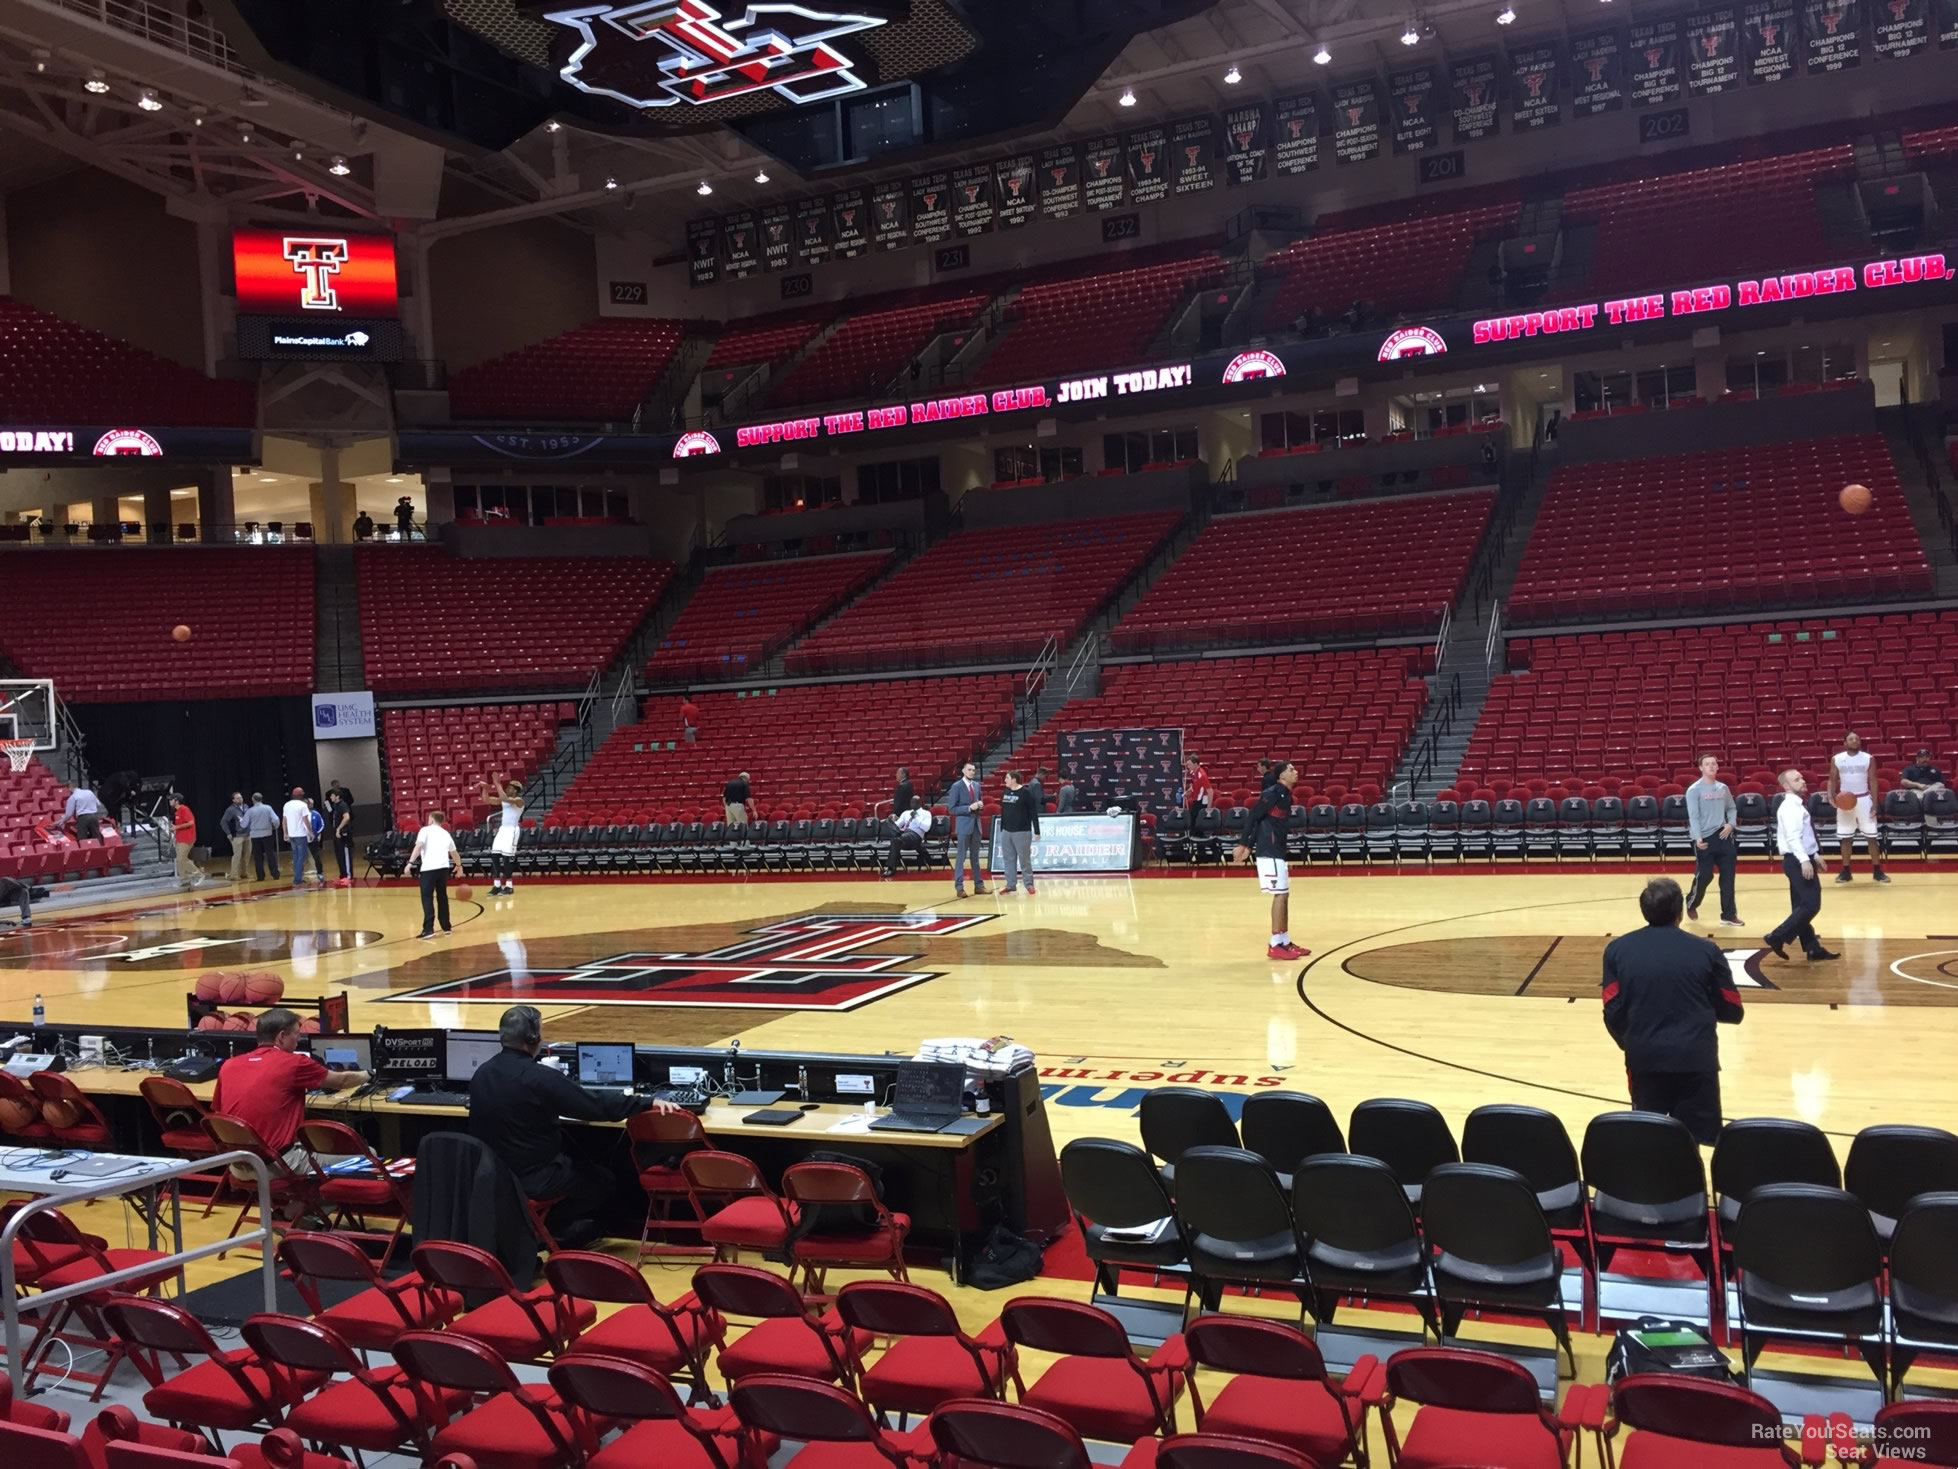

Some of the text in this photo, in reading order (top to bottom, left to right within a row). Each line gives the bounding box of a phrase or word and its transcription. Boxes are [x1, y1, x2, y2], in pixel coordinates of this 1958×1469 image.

[1876, 18, 1924, 35] CHAMPIONS
[1809, 32, 1856, 48] CHAMPIONS
[1887, 30, 1914, 42] BIG 12
[1820, 43, 1846, 55] BIG 12
[1874, 36, 1928, 53] TOURNAMENT
[1760, 47, 1783, 57] NCAA
[1807, 49, 1860, 66] CONFERENCE
[1893, 48, 1911, 59] 1999
[1690, 56, 1734, 71] CHAMPIONS
[1754, 53, 1789, 67] MIDWEST
[1825, 61, 1843, 71] 1999
[1633, 66, 1676, 81] CHAMPIONS
[1701, 67, 1725, 78] BIG 12
[1753, 62, 1792, 76] REGIONAL
[1585, 81, 1608, 93] NCAA
[1643, 77, 1667, 88] BIG 12
[1689, 72, 1738, 88] TOURNAMENT
[1591, 88, 1621, 102] REGIONAL
[1631, 83, 1680, 99] CONFERENCE
[1453, 102, 1497, 117] CO-CHAMPIONS
[1524, 97, 1547, 108] NCAA
[1227, 107, 1261, 124] MARSHA
[1514, 104, 1558, 121] SWEET SIXTEEN
[1232, 120, 1257, 135] SHARP
[1402, 116, 1425, 127] NCAA
[1458, 118, 1493, 131] CONFERENCE
[1646, 114, 1683, 137] 202
[1335, 123, 1378, 138] CHAMPIONS
[1397, 126, 1432, 141] ELITE EIGHT
[1276, 136, 1317, 151] CHAMPIONS
[1336, 142, 1378, 157] TOURNAMENT
[1407, 141, 1425, 152] 1995
[1277, 145, 1318, 160] SOUTHWEST
[1349, 152, 1366, 162] 1995
[1277, 154, 1318, 169] CONFERENCE
[1428, 157, 1456, 178] 201
[1239, 166, 1253, 176] YEAR
[1290, 164, 1307, 174] 1995
[1085, 175, 1122, 189] CHAMPIONS
[1179, 172, 1209, 184] SWEET
[1130, 182, 1169, 197] CONFERENCE
[1175, 179, 1214, 193] SIXTEEN
[1006, 197, 1026, 207] NCAA
[1043, 192, 1079, 205] SOUTHWEST
[1087, 191, 1123, 206] TOURNAMENT
[1135, 191, 1165, 204] CHAMPS
[958, 200, 990, 213] CHAMPIONS
[1043, 200, 1079, 214] CONFERENCE
[916, 209, 947, 221] CHAMPIONS
[1009, 215, 1025, 225] 1992
[880, 220, 899, 231] NCAA
[914, 216, 948, 229] SOUTHWEST
[1107, 218, 1135, 238] 232
[841, 228, 859, 239] NCAA
[913, 223, 951, 237] CONFERENCE
[967, 226, 982, 236] 1992
[804, 236, 822, 246] NCAA
[732, 251, 750, 260] NCAA
[766, 243, 789, 257] NWIT
[694, 257, 715, 270] NWIT
[943, 250, 963, 268] 231
[616, 286, 642, 301] 229
[785, 278, 809, 297] 230
[1473, 253, 1956, 344] SUPPORT THE RED RAIDER CLUB,
[1382, 328, 1443, 359] RED RAIDER CLUB
[1226, 352, 1283, 381] RED RAIDER CLUB
[737, 364, 1192, 447] SUPPORT THE RED RAIDER CLUB, JOIN TODAY!
[0, 432, 74, 452] ODAY!
[337, 704, 358, 712] UMC
[338, 710, 372, 719] HEALTH
[338, 718, 372, 726] SYSTEM
[1055, 824, 1088, 837] HOUSE
[1045, 843, 1127, 857] RAIDER
[1033, 856, 1108, 865] SKETBALL
